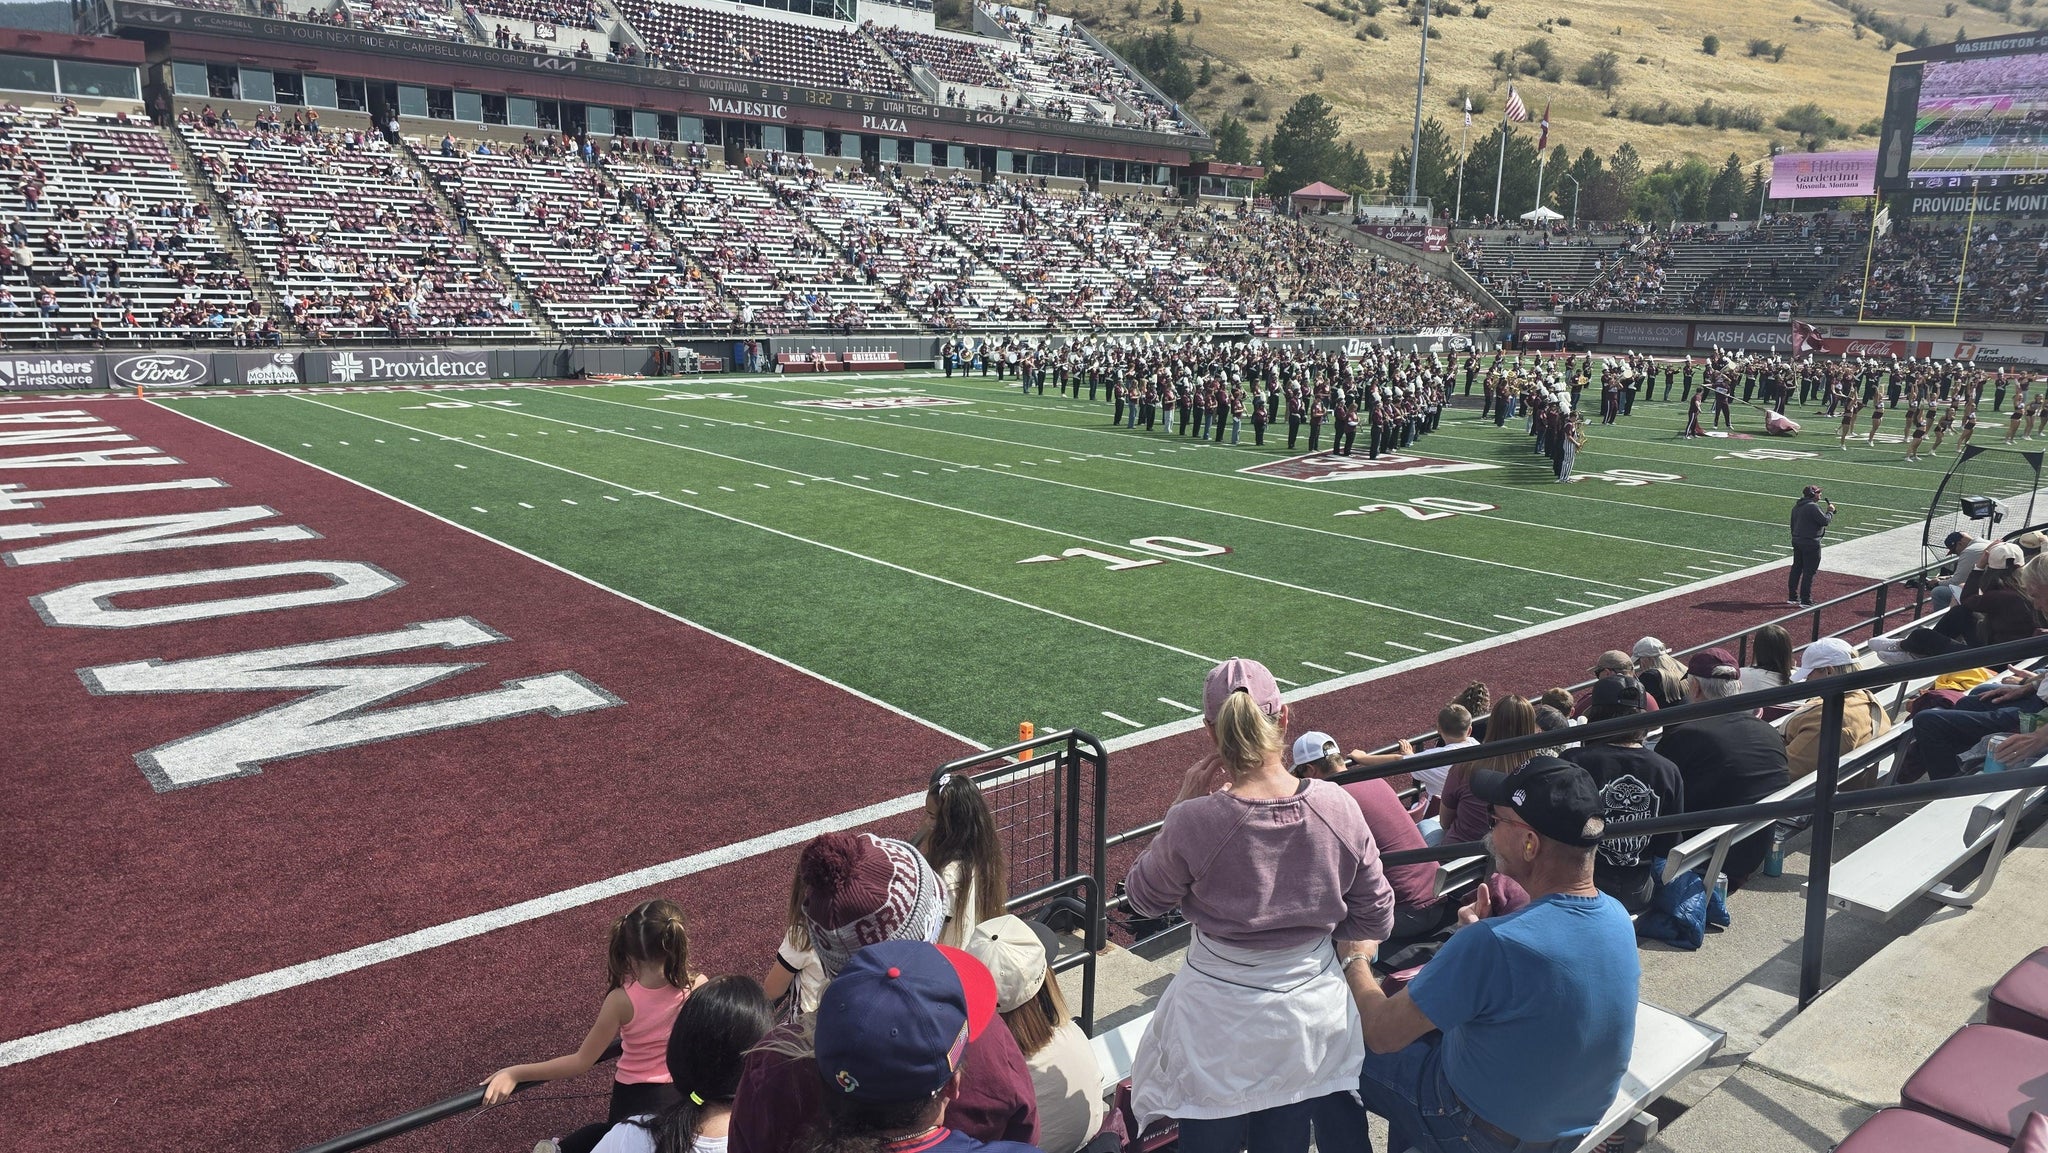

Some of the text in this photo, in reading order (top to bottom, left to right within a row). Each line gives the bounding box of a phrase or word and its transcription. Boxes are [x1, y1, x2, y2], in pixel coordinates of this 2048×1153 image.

[210, 18, 252, 29] CAMPBELL
[263, 24, 286, 36] GET
[290, 27, 323, 40] YOUR
[326, 31, 356, 44] NEXT
[360, 35, 385, 48] RIDE
[388, 39, 400, 50] AT
[403, 41, 460, 58] CAMPBELL
[462, 49, 482, 60] KIA!
[484, 51, 499, 62] GO
[502, 54, 527, 65] GRIZ!
[533, 56, 577, 72] KIA
[678, 78, 690, 88] 21
[699, 79, 749, 94] MONTANA
[53, 95, 66, 103] 127
[761, 89, 768, 98] 2
[782, 91, 788, 100] 3
[805, 91, 832, 106] 13:22
[269, 104, 282, 113] 126
[708, 97, 788, 119] MAJESTIC
[846, 100, 852, 109] 2
[864, 101, 874, 111] 37
[882, 101, 905, 113] UTAH
[907, 104, 928, 115] TECH
[862, 115, 908, 133] PLAZA
[1811, 160, 1860, 173] Hilton
[1796, 173, 1859, 183] Garden Inn
[1948, 177, 1961, 187] 21
[1990, 179, 1998, 187] 3
[2013, 174, 2047, 185] 13:22
[1913, 196, 2002, 213] PROVIDENCE
[1386, 226, 1424, 241] Sawyer
[1424, 228, 1447, 245] Sawyer
[1606, 325, 1645, 336] HEENAN
[1646, 328, 1653, 336] &
[1655, 326, 1685, 336] COOK
[1696, 331, 1793, 344] MARSH AGENC
[852, 353, 890, 361] GRIZZLIES
[1978, 347, 1999, 355] First
[1975, 354, 2019, 363] Interstate
[16, 359, 93, 376] Builders
[131, 358, 190, 381] Ford
[370, 355, 487, 379] Providence
[17, 374, 93, 386] FirstSource
[249, 371, 296, 379] MONTANA
[1358, 497, 1500, 521] 20
[1061, 536, 1232, 571] 10
